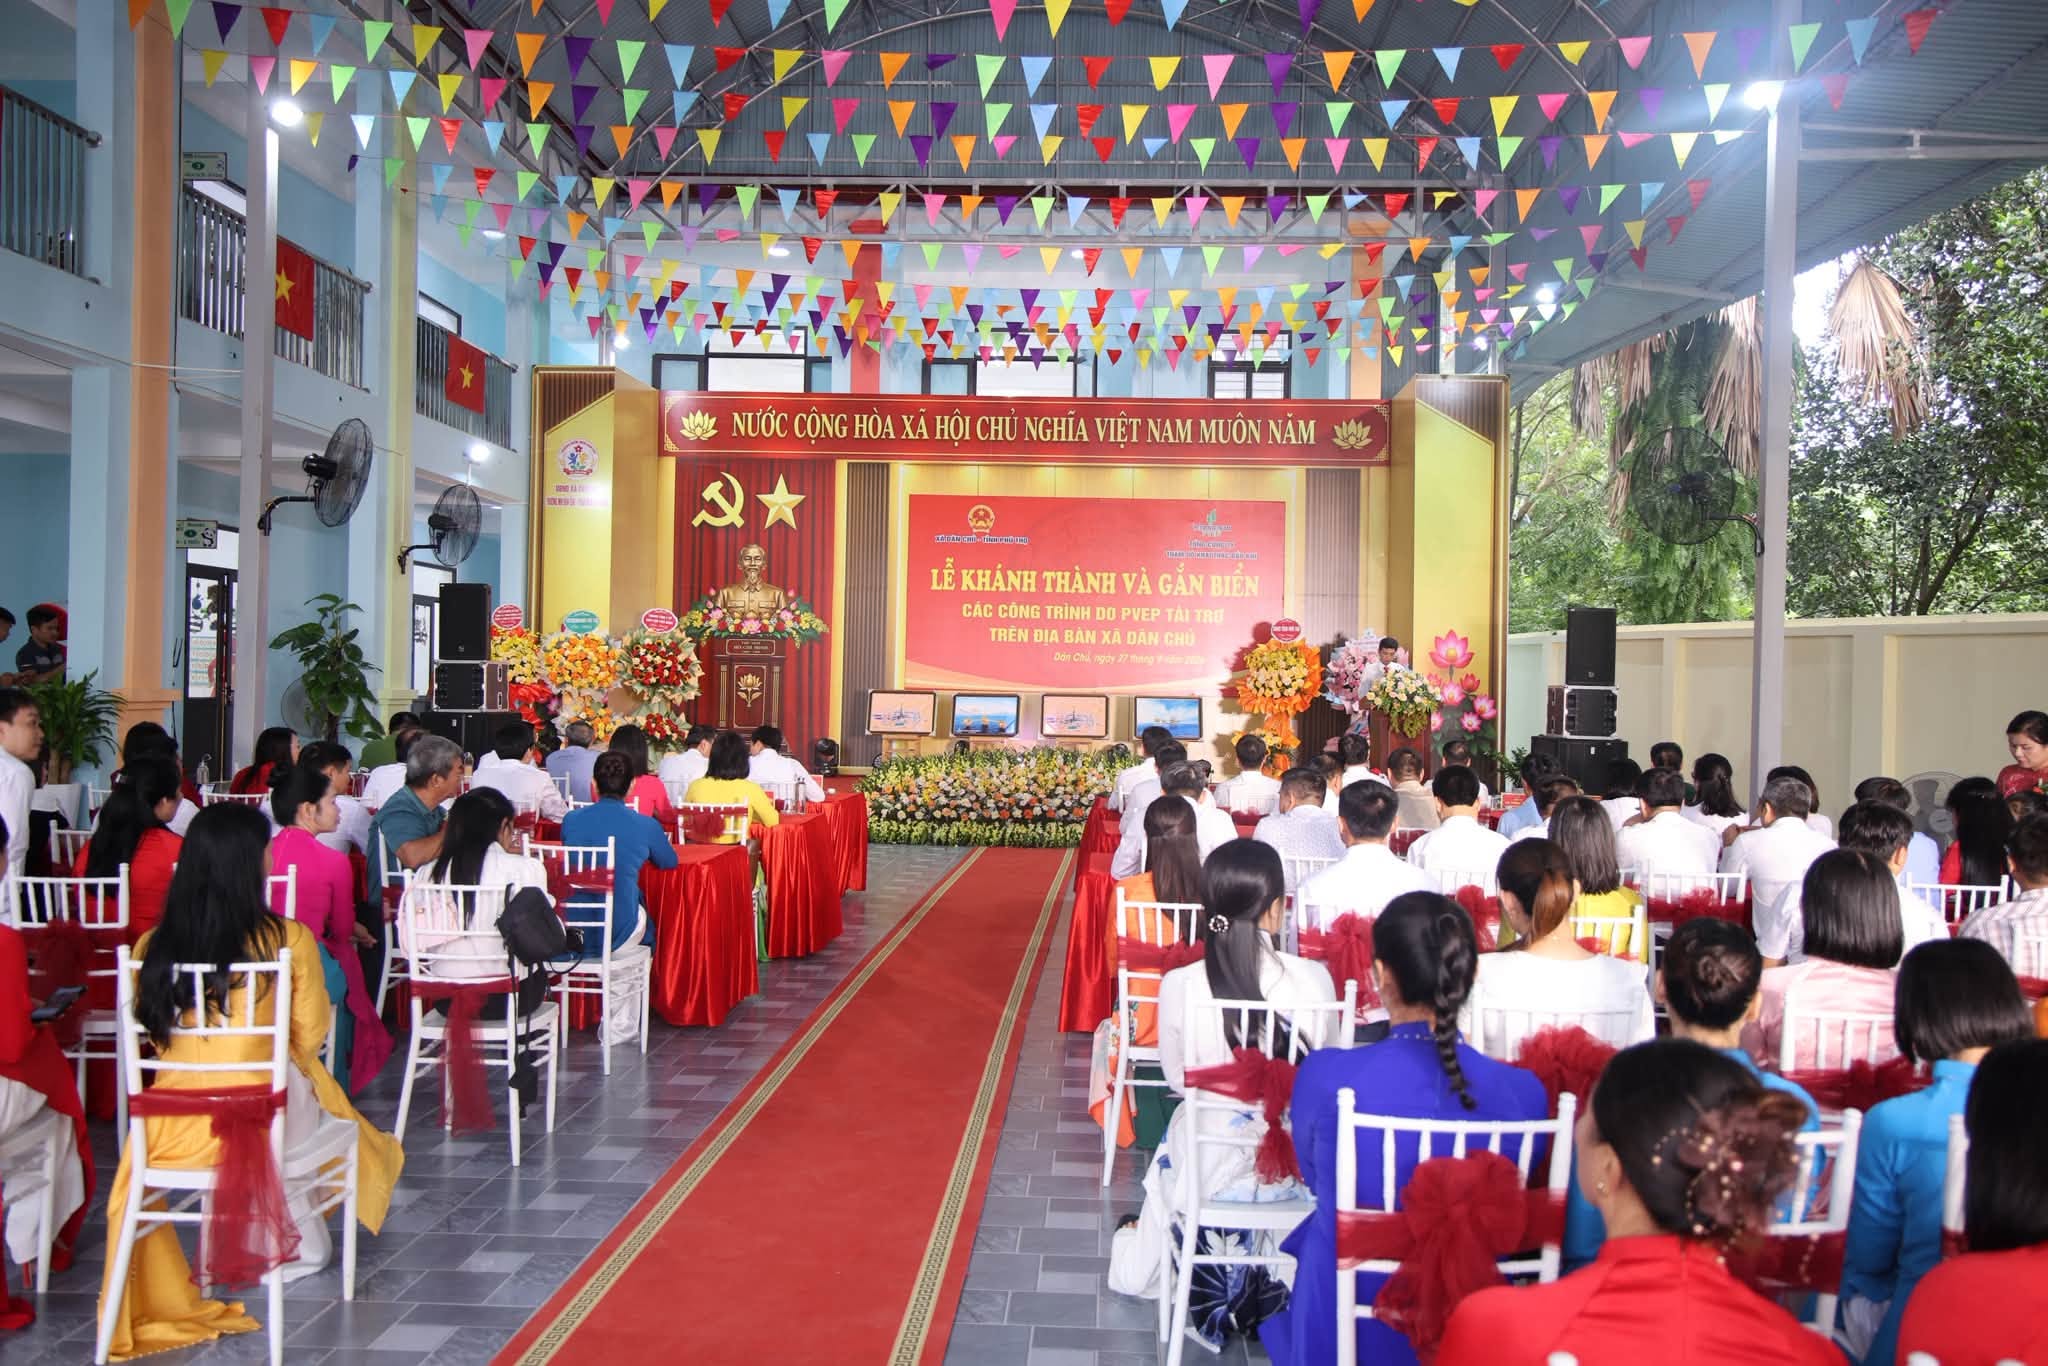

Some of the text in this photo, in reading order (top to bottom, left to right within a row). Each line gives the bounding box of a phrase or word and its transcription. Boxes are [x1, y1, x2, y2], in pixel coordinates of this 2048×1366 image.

[731, 405, 1317, 448] NƯỚC CỘNG HÒA XÃ HỘI CHỦ NGHĨA VIỆT NAM MUÔN NĂM
[930, 557, 1260, 598] LỄ KHÁNH THÀNH VÀ GẮN BIỂN
[962, 600, 993, 618] CÁC
[998, 601, 1041, 619] CÔNG
[1045, 602, 1091, 621] TRÌNH
[1095, 606, 1116, 621] DO
[1121, 607, 1161, 622] PVEP
[1165, 604, 1191, 623] TÀI
[989, 625, 1196, 647] TRÊN ĐỊA BÀN XÃ DÂN CHỦ
[1053, 651, 1071, 662] Dân
